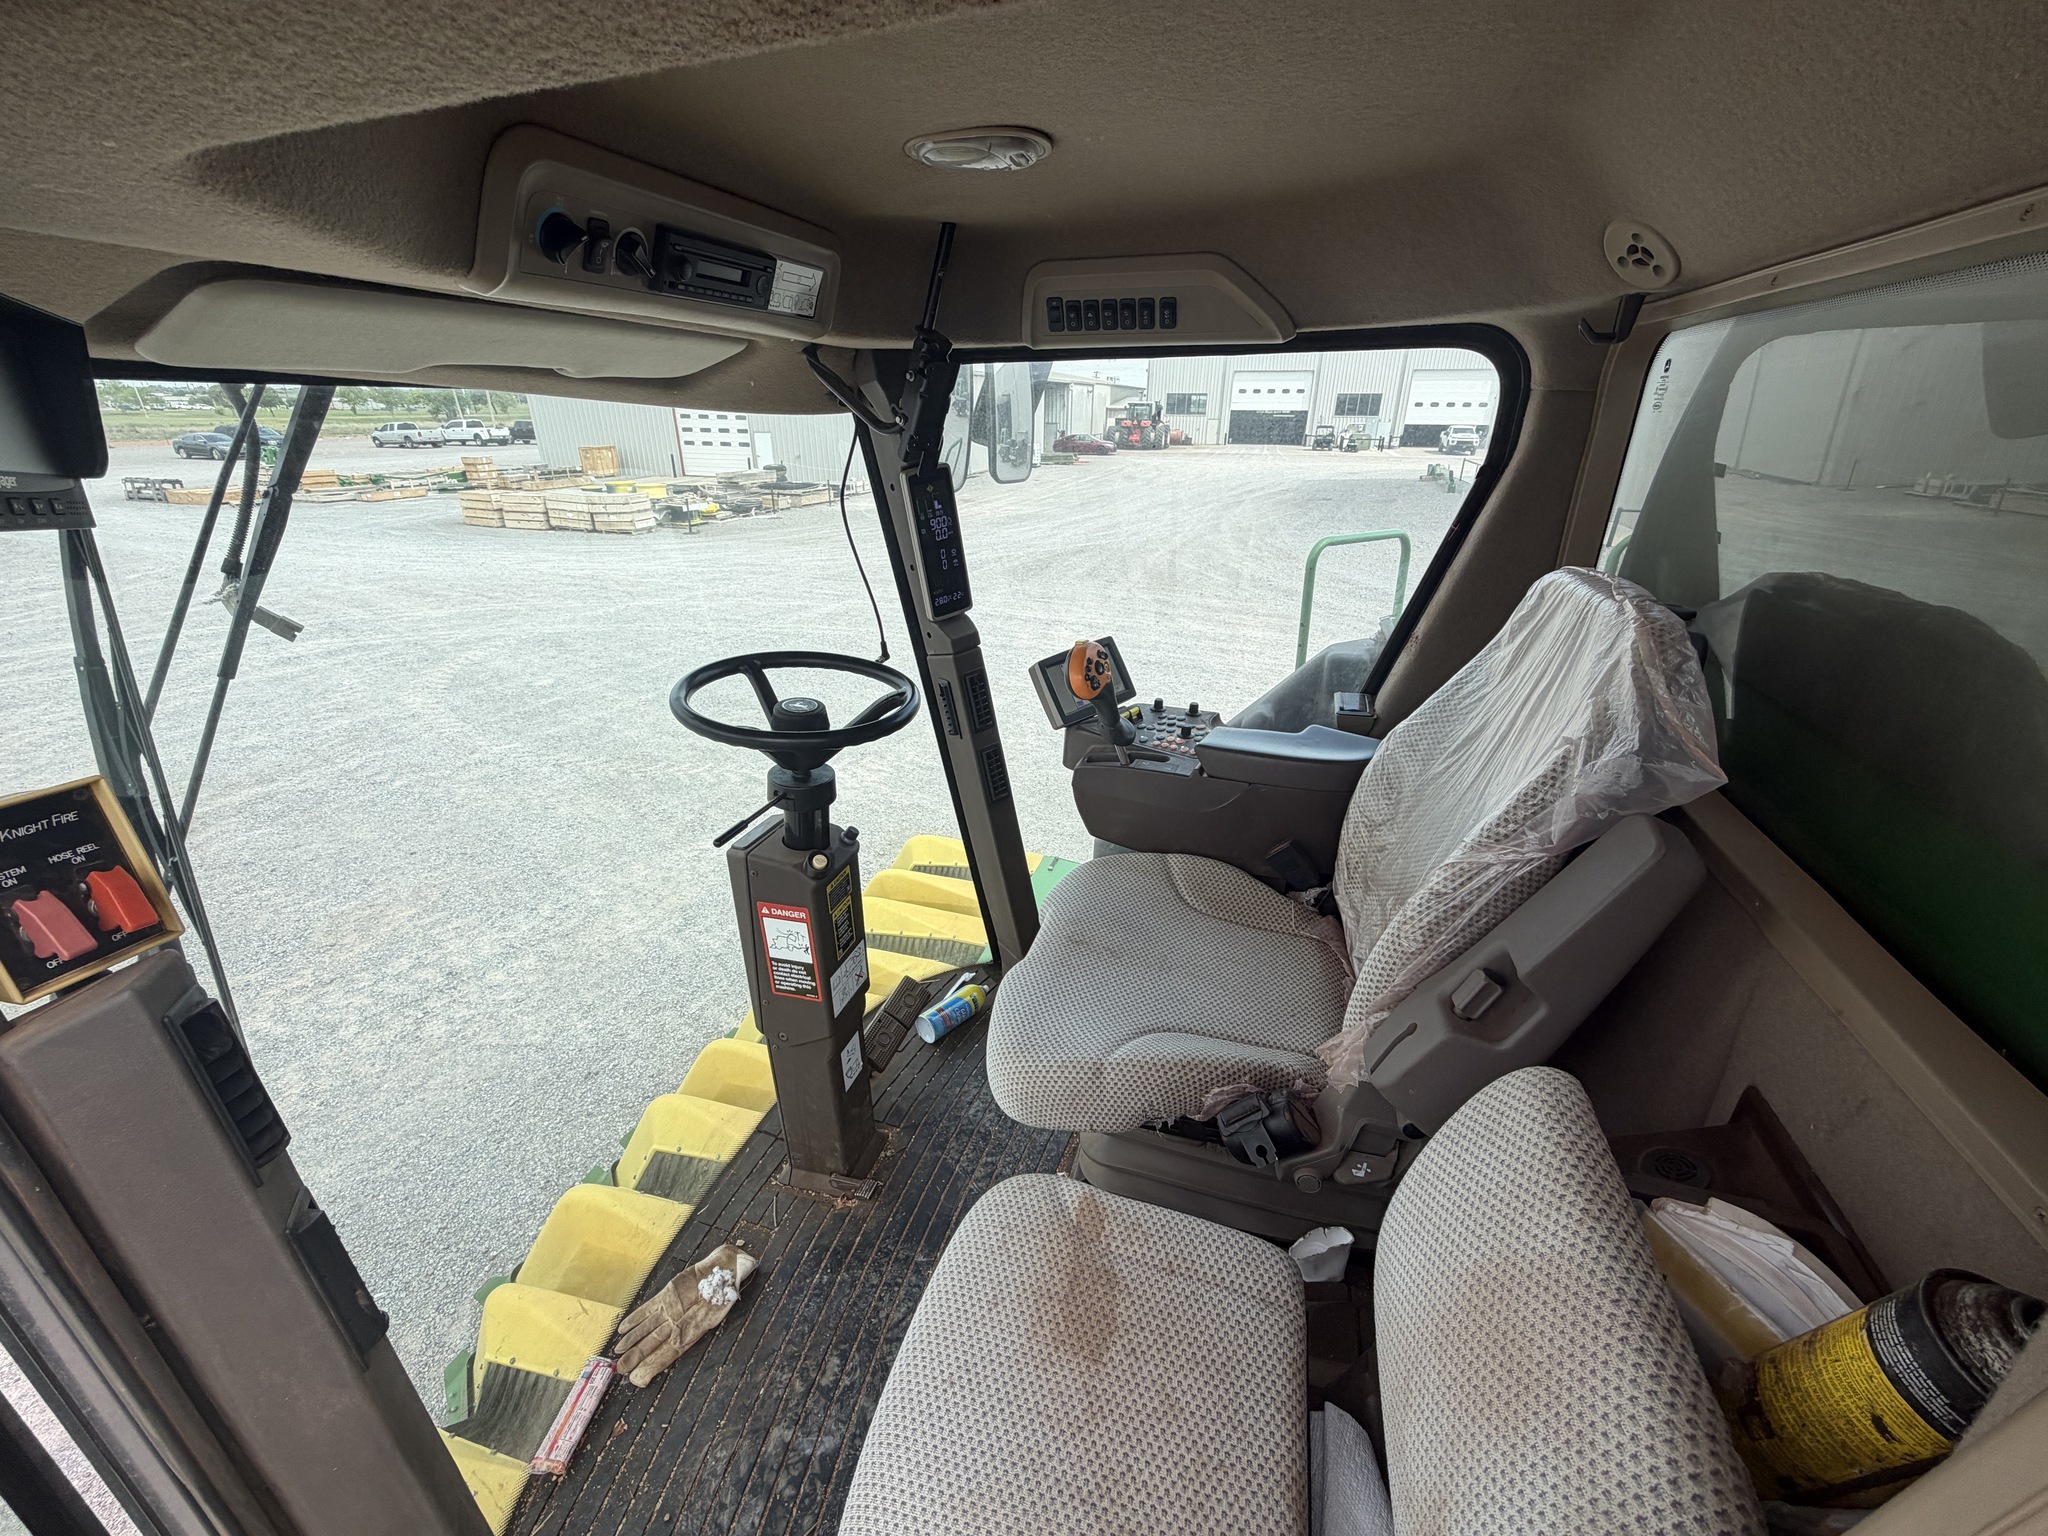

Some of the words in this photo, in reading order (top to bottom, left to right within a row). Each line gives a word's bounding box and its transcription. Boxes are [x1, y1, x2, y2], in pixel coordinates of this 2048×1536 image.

[930, 516, 947, 530] 900
[0, 819, 49, 842] KNIGHT
[51, 811, 79, 827] FIRE
[48, 850, 75, 864] HOSE
[76, 843, 100, 855] REEL
[71, 855, 86, 865] ON
[1, 877, 18, 888] ON
[771, 908, 807, 919] DANGER
